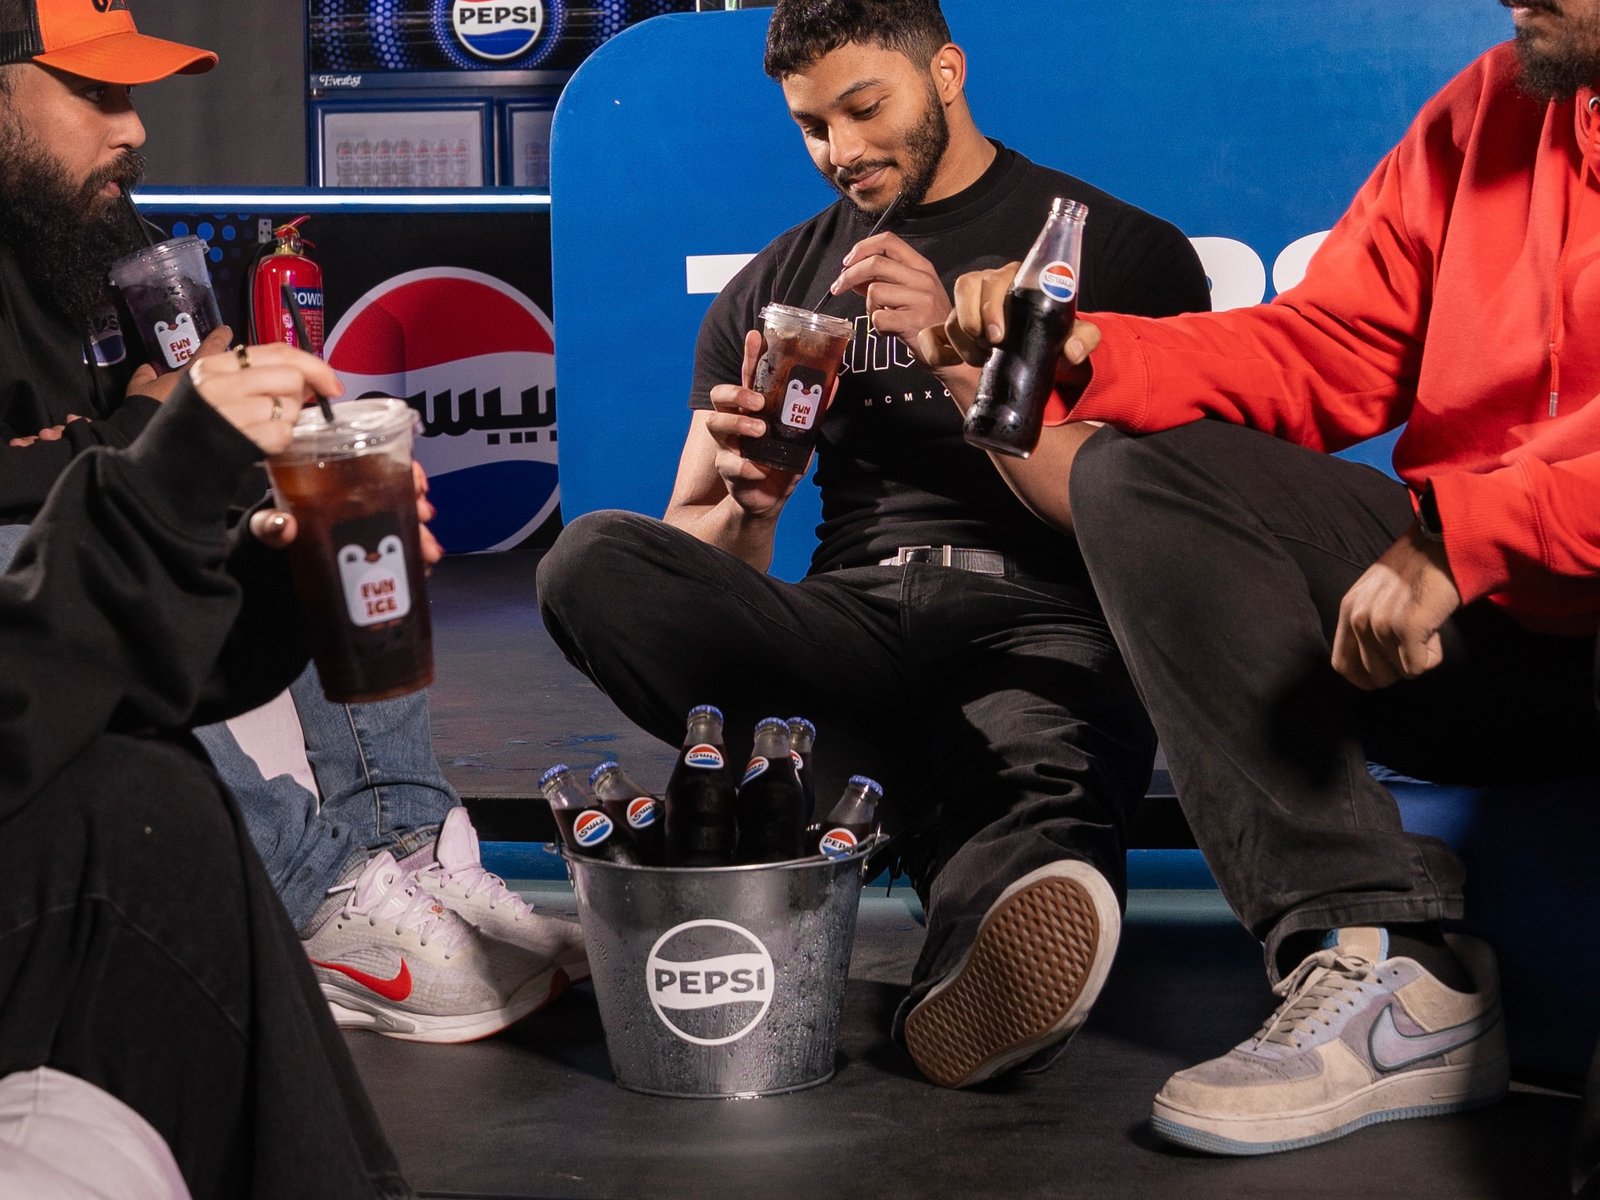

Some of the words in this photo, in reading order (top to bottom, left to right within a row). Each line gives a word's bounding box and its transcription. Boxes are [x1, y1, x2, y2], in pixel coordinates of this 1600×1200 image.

[459, 6, 536, 24] PEPSI
[292, 291, 322, 306] OWD
[169, 337, 191, 353] FUN
[174, 348, 194, 362] ICE
[792, 403, 811, 415] FUN
[790, 413, 807, 425] ICE
[361, 578, 396, 598] FUN
[366, 597, 397, 616] ICE
[824, 837, 846, 850] PEP
[655, 967, 765, 995] PEPSI
